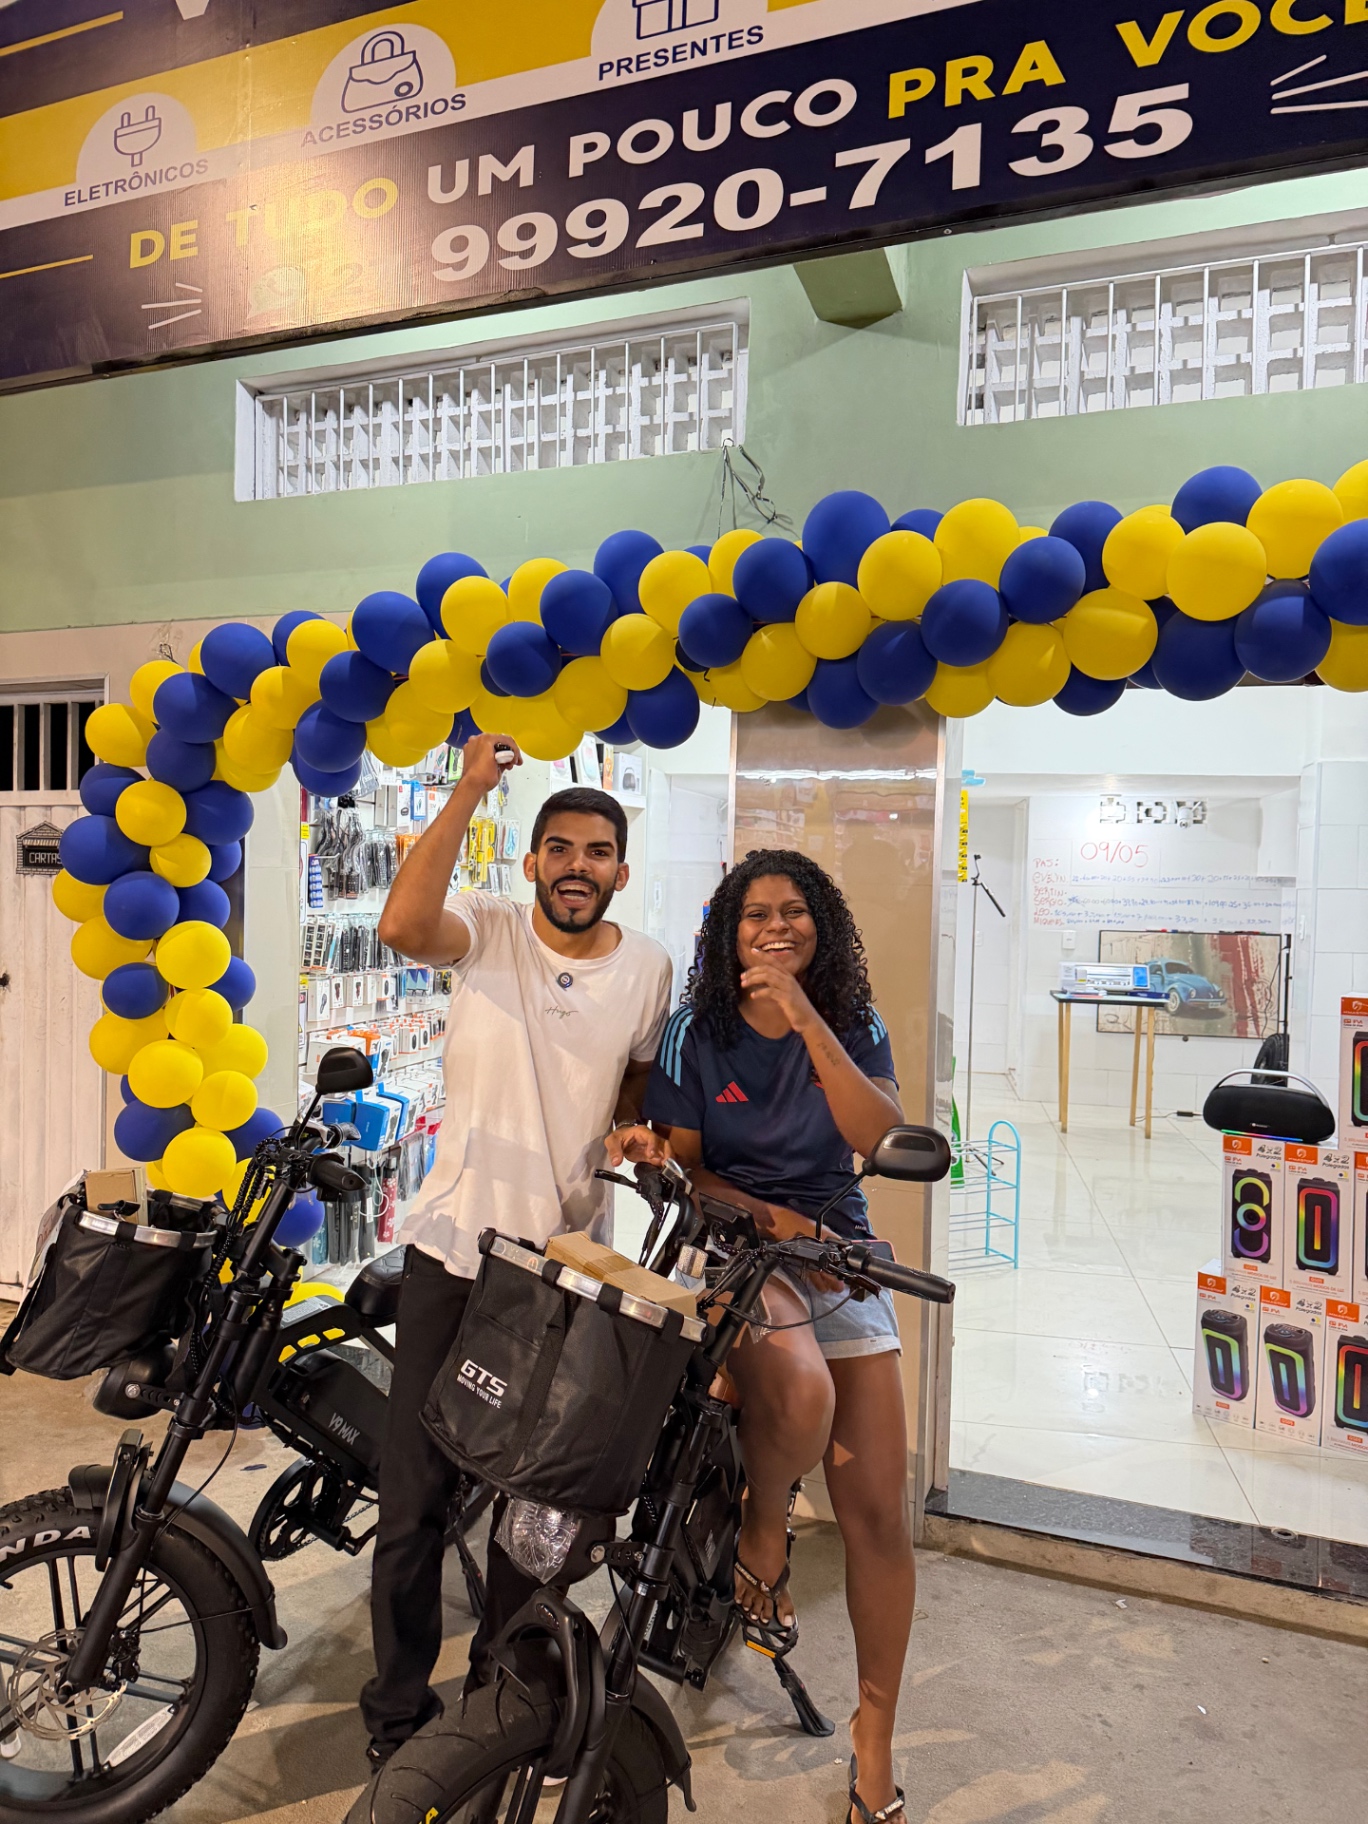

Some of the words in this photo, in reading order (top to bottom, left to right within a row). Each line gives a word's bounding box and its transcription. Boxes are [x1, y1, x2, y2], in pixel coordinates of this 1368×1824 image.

[598, 25, 764, 81] PRESENTES
[301, 93, 467, 147] ACESSÓRIOS
[129, 220, 198, 269] DE
[226, 177, 399, 248] TUDO
[426, 144, 535, 204] UM
[568, 78, 858, 180] POUCO
[887, 39, 1066, 119] PRA
[64, 158, 209, 206] ELETRÔNICOS
[430, 82, 1194, 282] 99920-7135
[28, 851, 63, 865] CARTAS
[1080, 841, 1149, 868] 09/05
[456, 1373, 476, 1392] MOVING
[476, 1386, 490, 1402] YOUR
[488, 1395, 503, 1409] LIFE
[460, 1359, 508, 1397] GTS
[337, 1421, 361, 1446] MAX
